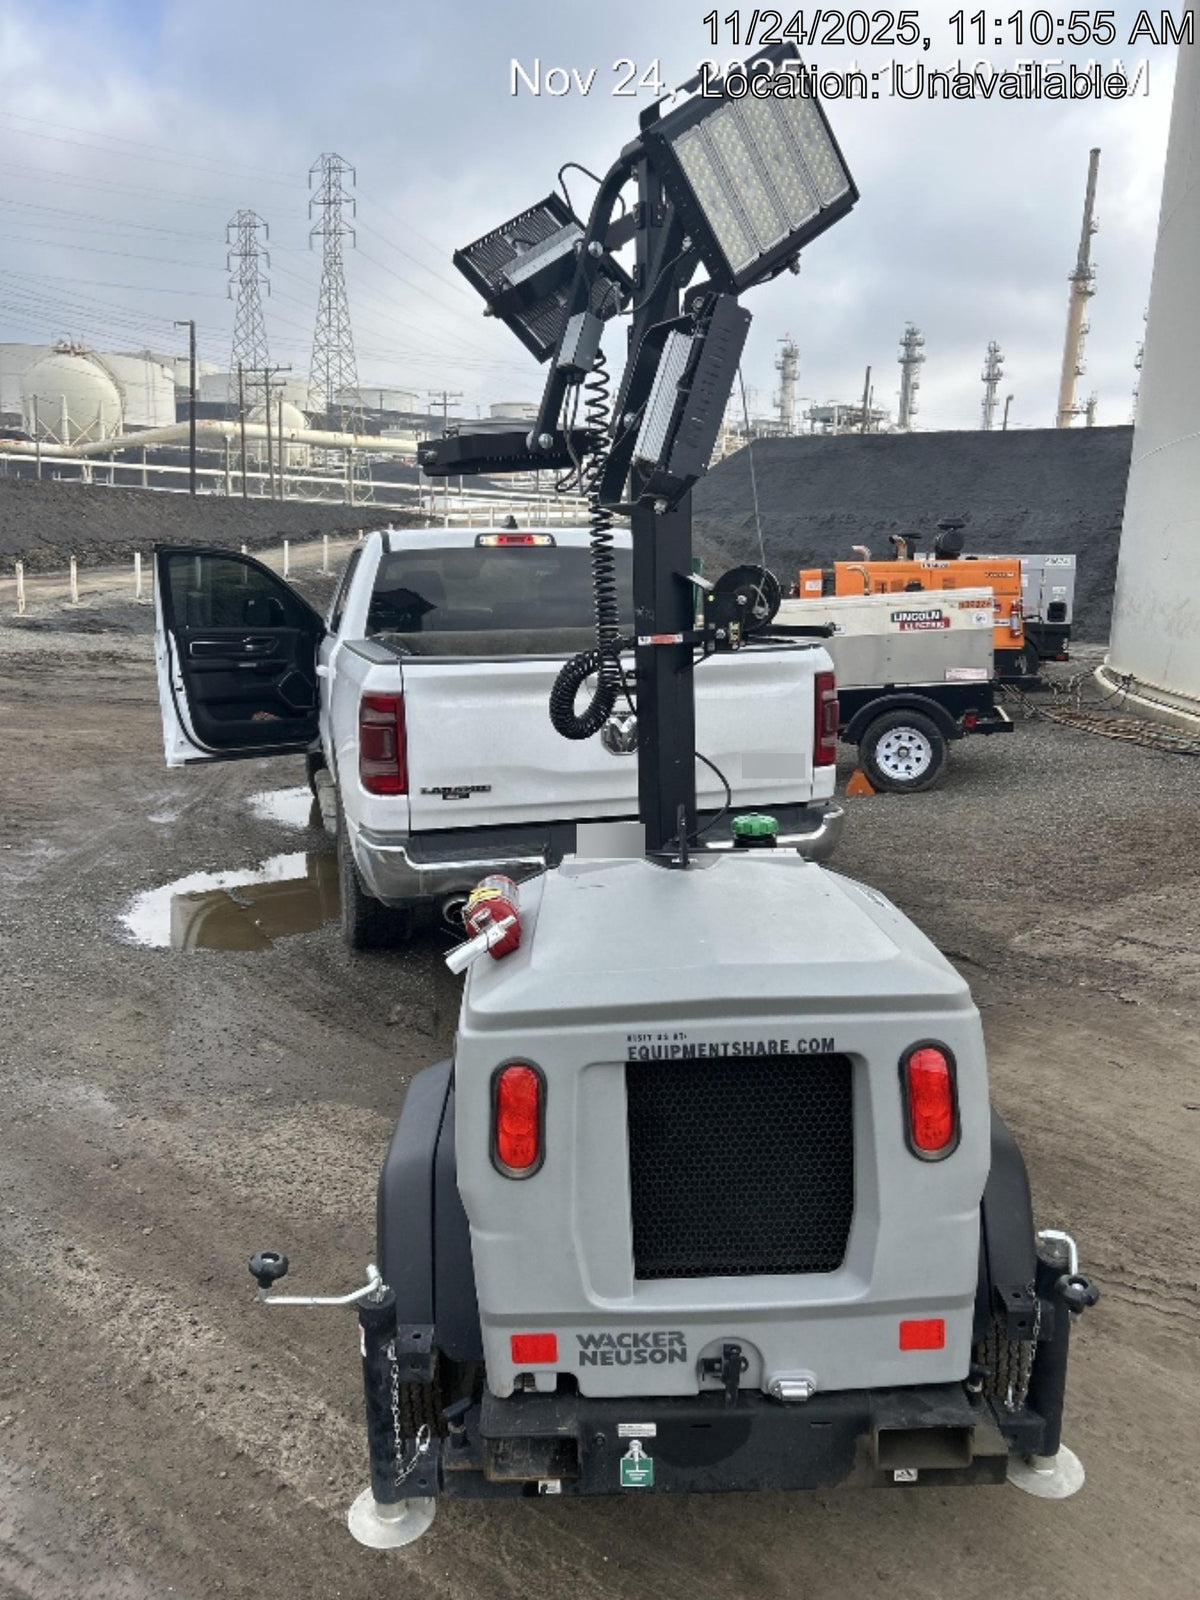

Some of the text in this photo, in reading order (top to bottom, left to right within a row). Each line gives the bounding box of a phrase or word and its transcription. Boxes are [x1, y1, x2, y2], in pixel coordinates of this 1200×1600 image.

[893, 610, 941, 622] LINCOLN
[627, 1037, 836, 1061] EQUIPMENTSHARE.COM
[576, 1330, 687, 1350] WACKER
[579, 1347, 687, 1366] NEUSON
